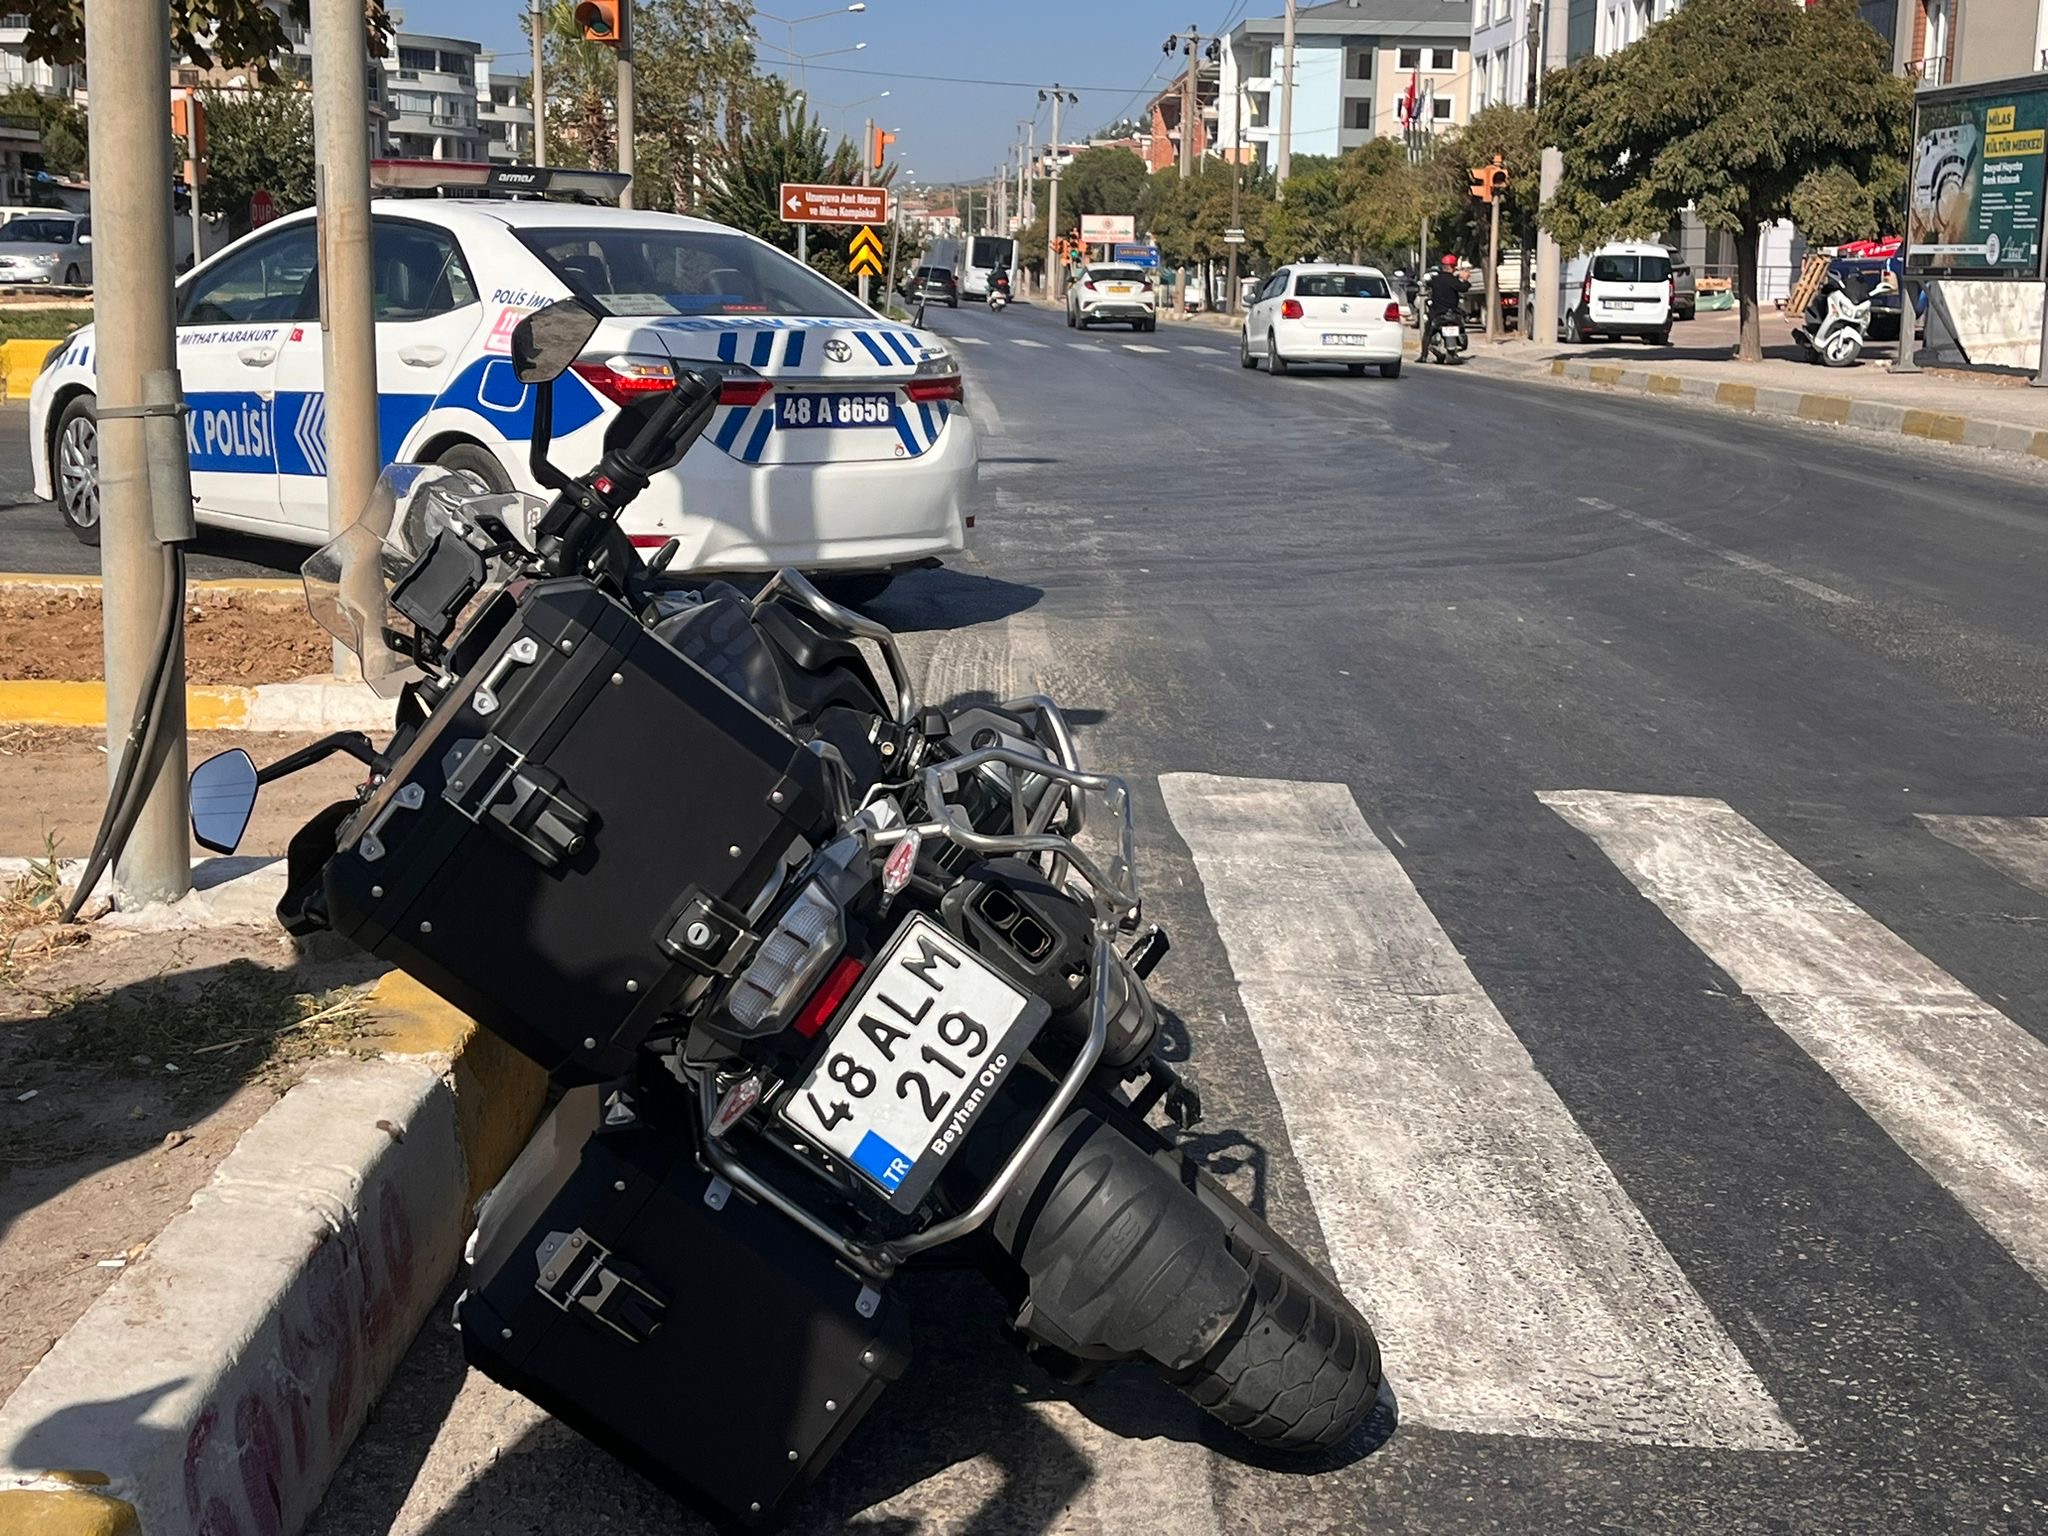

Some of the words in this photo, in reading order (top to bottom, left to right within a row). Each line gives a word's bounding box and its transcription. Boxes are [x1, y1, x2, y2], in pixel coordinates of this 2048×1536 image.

[1988, 111, 2012, 126] MİLAS
[1986, 137, 2011, 153] KÜLTÜR
[498, 173, 536, 183] armas
[805, 191, 840, 205] Uzunyuva
[252, 203, 272, 221] DUR
[809, 207, 818, 216] ve
[819, 205, 838, 217] Müze
[491, 288, 528, 304] POLİS
[179, 331, 219, 345] MİTHAT
[218, 329, 279, 343] KARAKURT
[783, 397, 811, 425] 48
[817, 396, 833, 424] A
[837, 395, 889, 423] 8656
[203, 401, 271, 458] POLİSİ
[807, 1053, 877, 1131] 48
[858, 935, 961, 1062] ALM
[896, 1010, 988, 1122] 219
[931, 1087, 985, 1156] Beyhan
[979, 1054, 1008, 1087] Oto
[883, 1157, 909, 1182] TR
